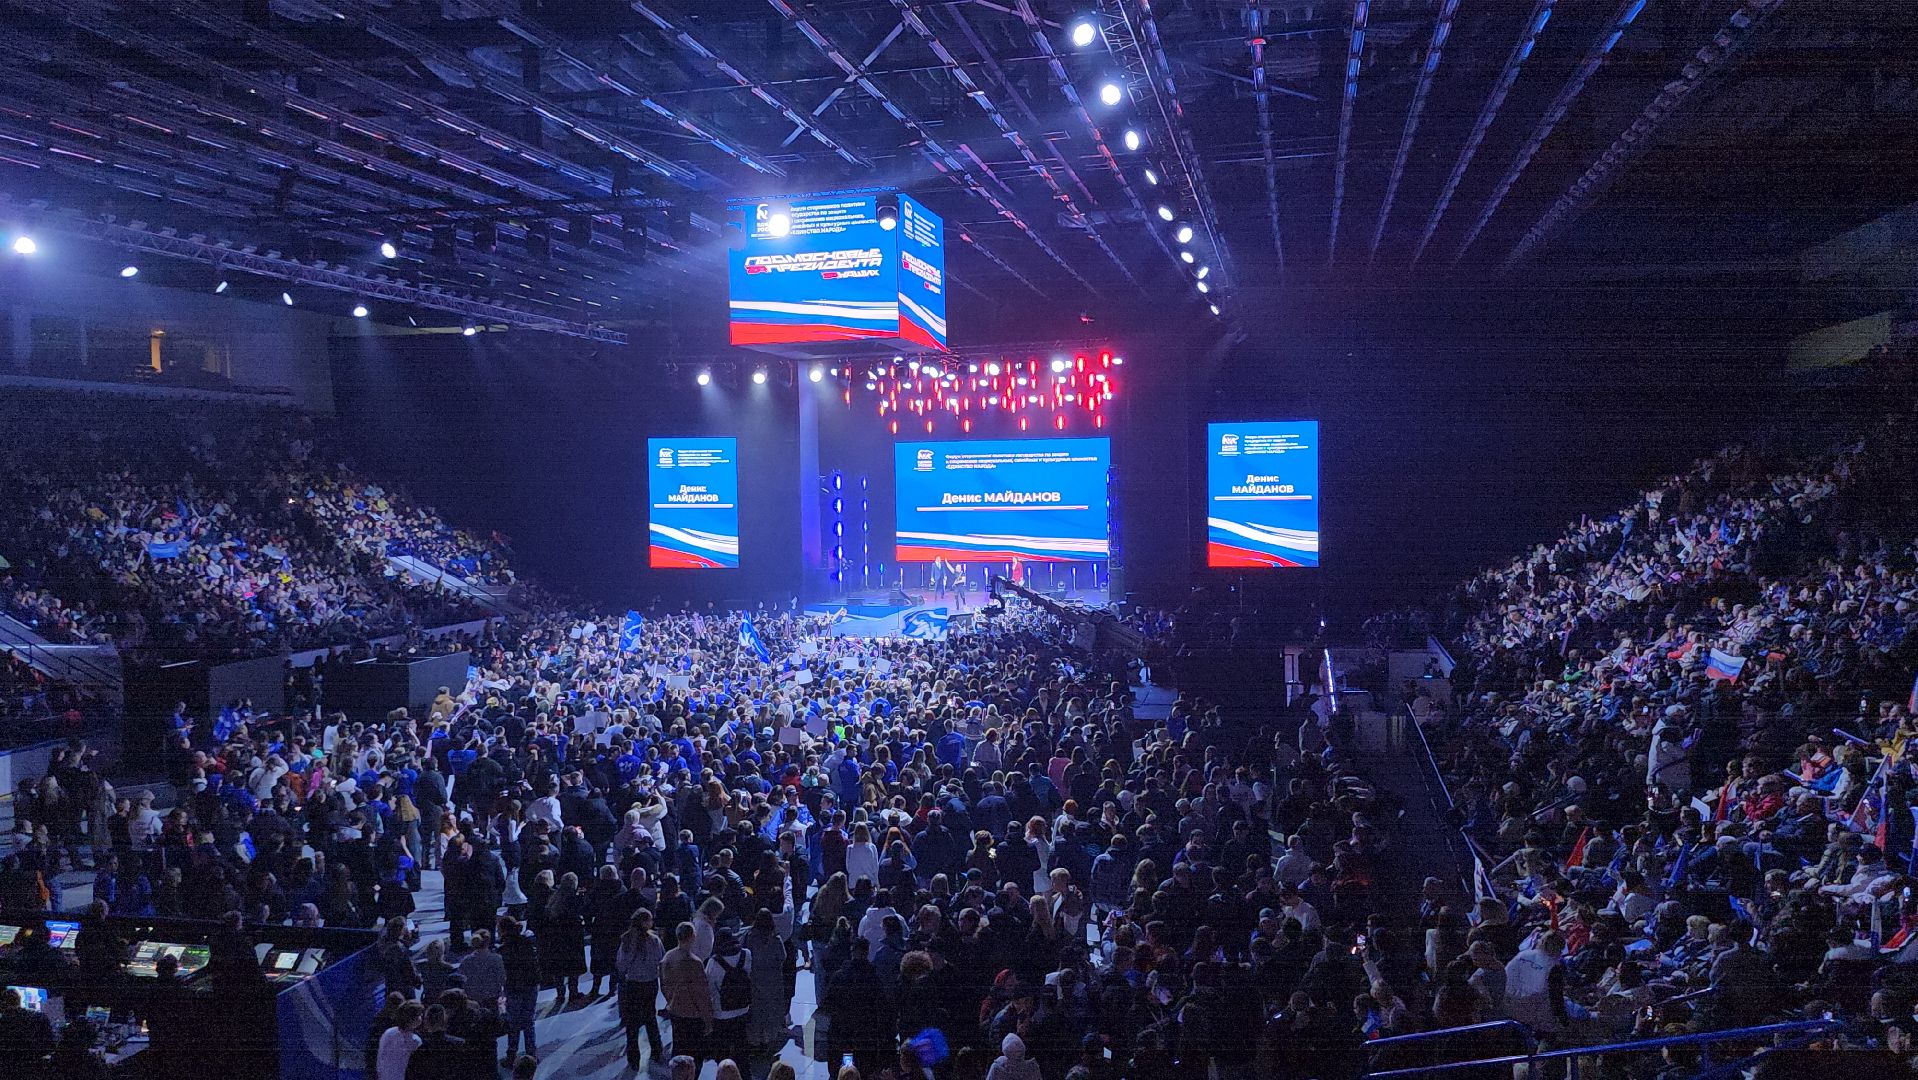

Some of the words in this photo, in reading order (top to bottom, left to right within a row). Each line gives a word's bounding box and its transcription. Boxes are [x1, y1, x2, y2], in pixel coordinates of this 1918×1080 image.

[1246, 474, 1280, 484] Денис
[679, 484, 707, 494] Денис
[1232, 484, 1294, 494] МАЙДАНОВ
[668, 493, 719, 503] МАЙДАНОВ
[941, 492, 982, 504] Денис
[984, 490, 1061, 504] МАЙДАНОВ
